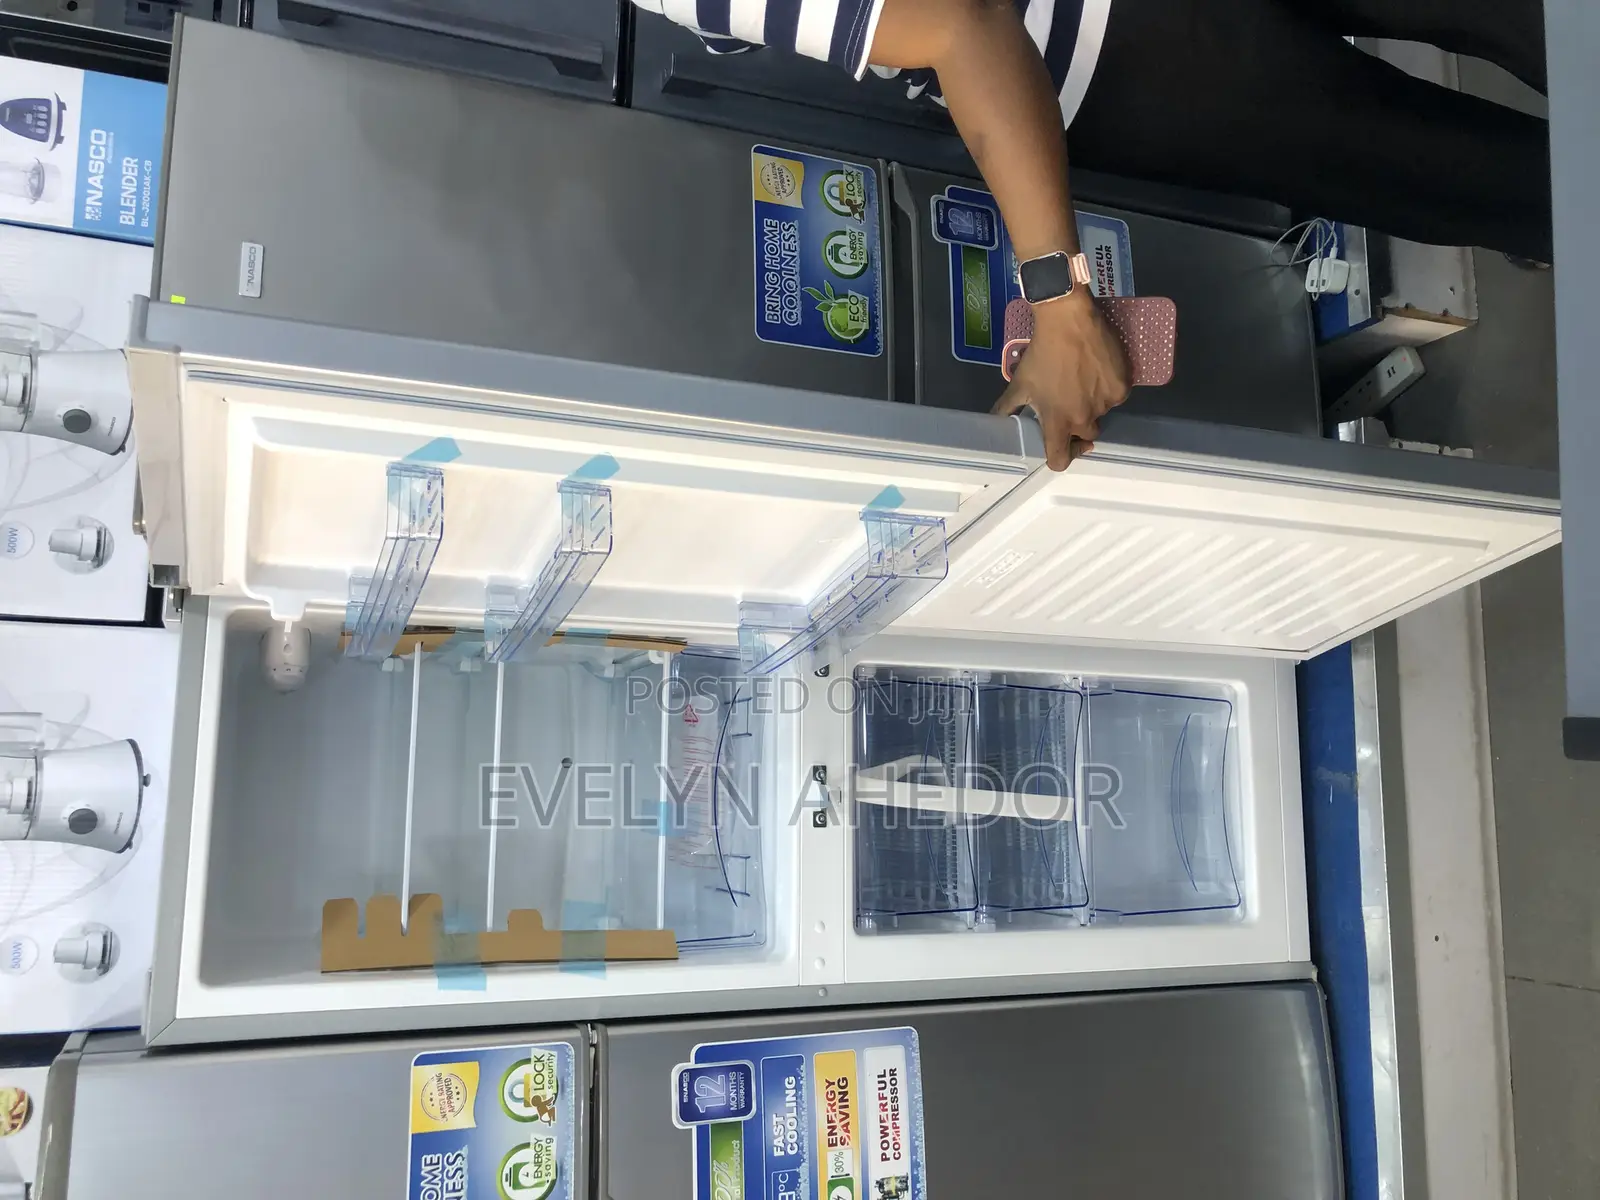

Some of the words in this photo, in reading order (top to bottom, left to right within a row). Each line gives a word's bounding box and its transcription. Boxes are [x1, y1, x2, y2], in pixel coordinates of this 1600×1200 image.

[86, 129, 107, 206] NASCO
[844, 170, 856, 197] LOCK
[854, 171, 864, 198] security
[119, 157, 138, 225] BLENDER
[947, 208, 974, 236] 12
[975, 211, 984, 240] MONTHS
[763, 218, 780, 270] HOME
[848, 230, 858, 260] ENERGY
[856, 232, 866, 260] saving
[247, 247, 257, 284] NASCO
[781, 221, 800, 326] COOLNESS
[764, 271, 781, 324] BRING
[848, 295, 860, 323] ECO
[859, 297, 869, 323] friendly
[6, 527, 18, 554] 500W
[10, 942, 23, 970] 500W
[435, 1072, 446, 1097] RATING
[533, 1054, 545, 1092] LOCK
[544, 1052, 556, 1090] security
[443, 1077, 456, 1113] APPROVED
[693, 1075, 727, 1113] 12
[729, 1071, 739, 1110] MONTHS
[784, 1076, 800, 1155] COOLING
[824, 1078, 838, 1149] ENERGY
[837, 1076, 851, 1147] SAVING
[876, 1069, 891, 1162] POWERFUL
[888, 1067, 901, 1161] COMPRESSOR
[772, 1113, 785, 1157] FAST
[532, 1137, 544, 1179] ENERGY
[543, 1137, 554, 1178] saving
[731, 1140, 741, 1180] Product
[833, 1151, 845, 1174] 30%
